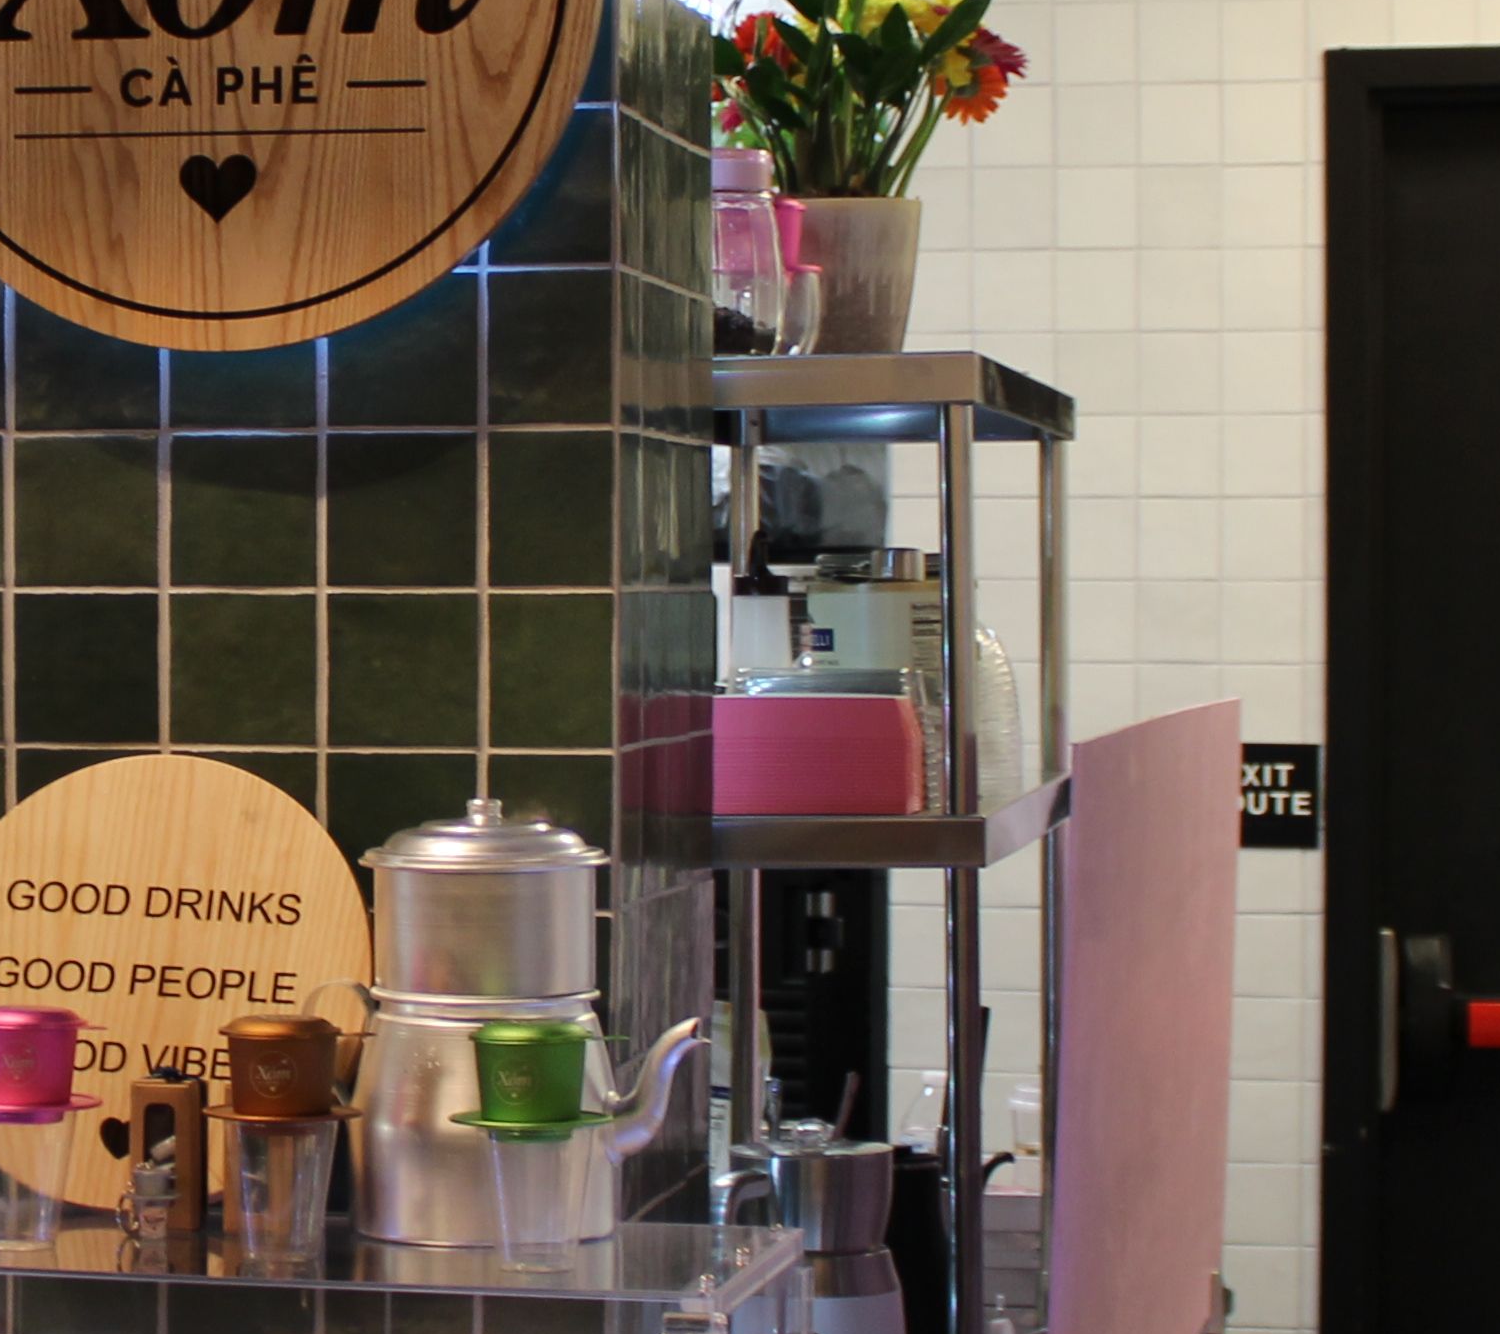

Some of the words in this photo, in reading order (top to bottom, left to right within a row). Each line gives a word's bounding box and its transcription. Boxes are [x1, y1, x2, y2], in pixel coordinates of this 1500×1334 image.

[120, 57, 193, 109] CÀ
[215, 53, 319, 107] PHÊ
[1241, 763, 1295, 787] XIT
[1238, 791, 1312, 816] UTE
[6, 878, 132, 917] GOOD
[143, 885, 303, 927] DRINKS
[129, 962, 299, 1006] PEOPLE
[73, 1038, 127, 1073] OD
[142, 1043, 230, 1080] VIBE
